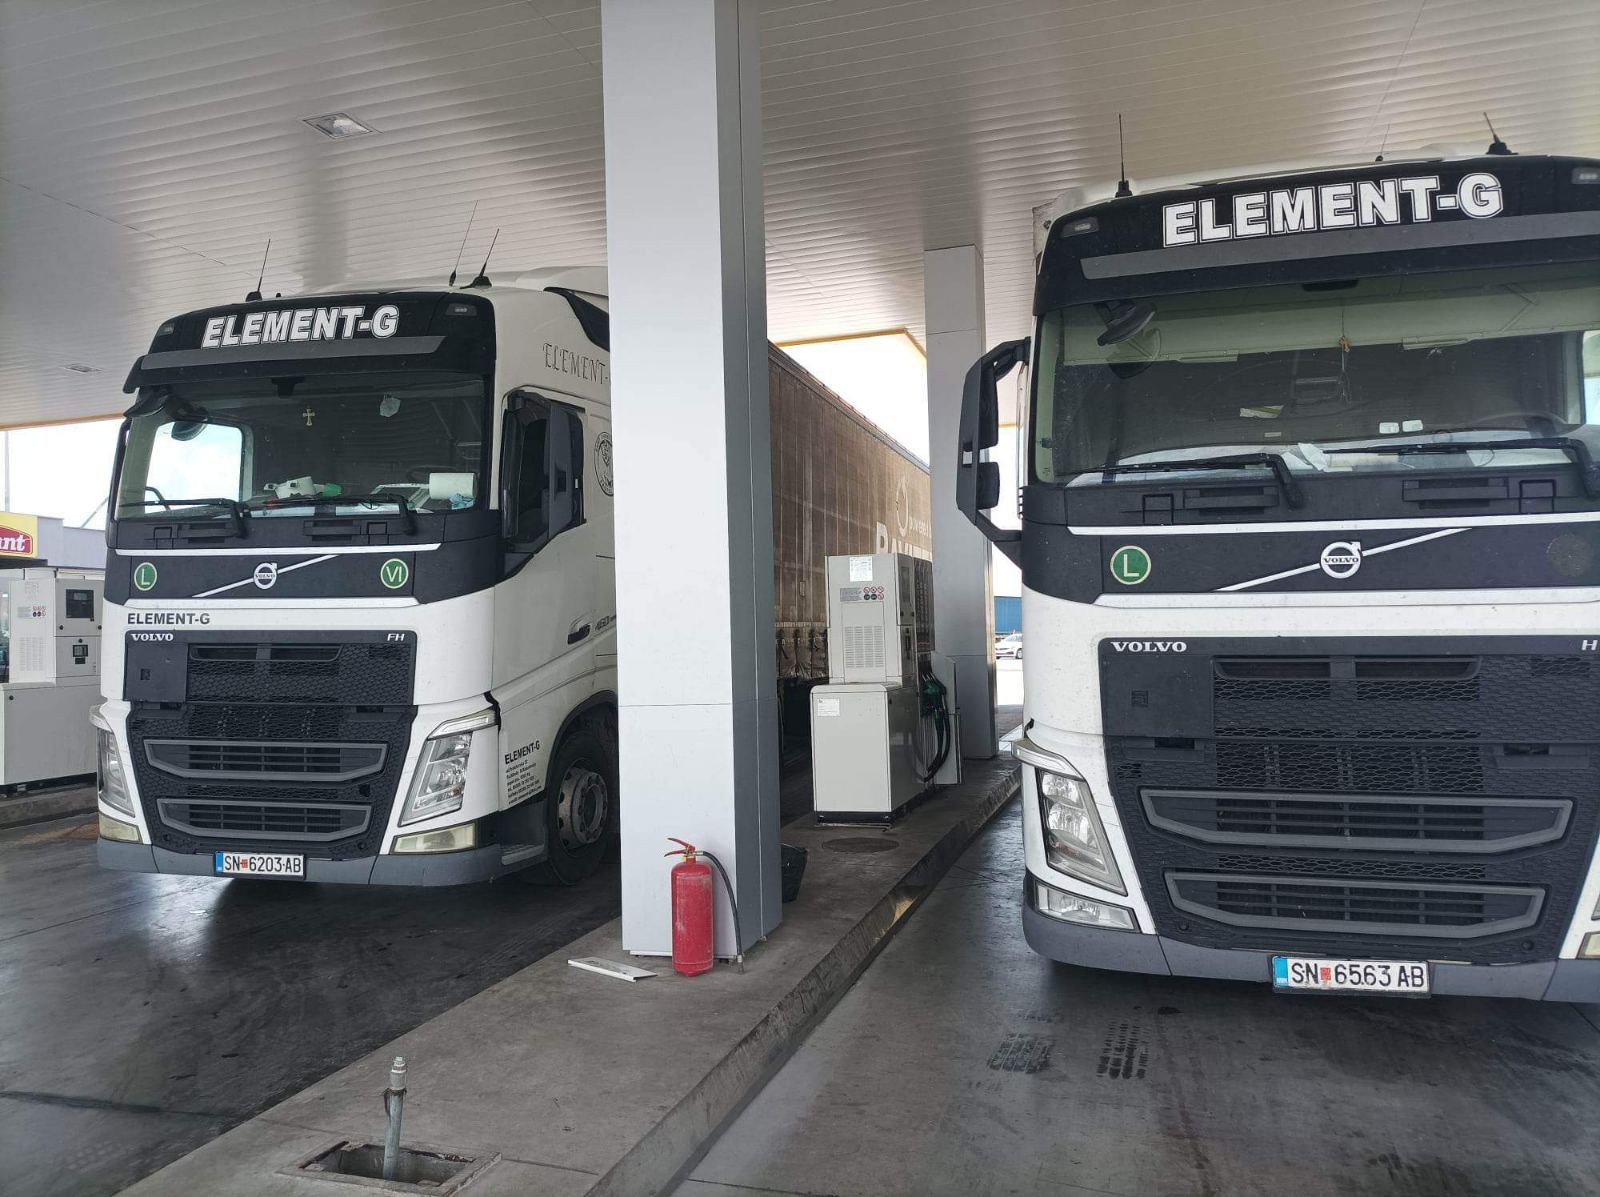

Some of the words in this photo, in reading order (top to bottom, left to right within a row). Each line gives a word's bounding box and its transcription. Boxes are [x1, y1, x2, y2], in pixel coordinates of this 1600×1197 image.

[1163, 172, 1504, 247] ELEMENT-G
[201, 305, 399, 349] ELEMENT-G
[543, 343, 609, 385] ELEMENT-
[0, 535, 25, 551] nt
[1123, 553, 1140, 577] L
[387, 566, 402, 582] VI
[127, 613, 210, 625] ELEMENT-G
[131, 633, 174, 641] VOLVO
[387, 633, 405, 641] FH
[1111, 642, 1187, 652] VOLVO
[504, 740, 540, 764] ELEMENT-G
